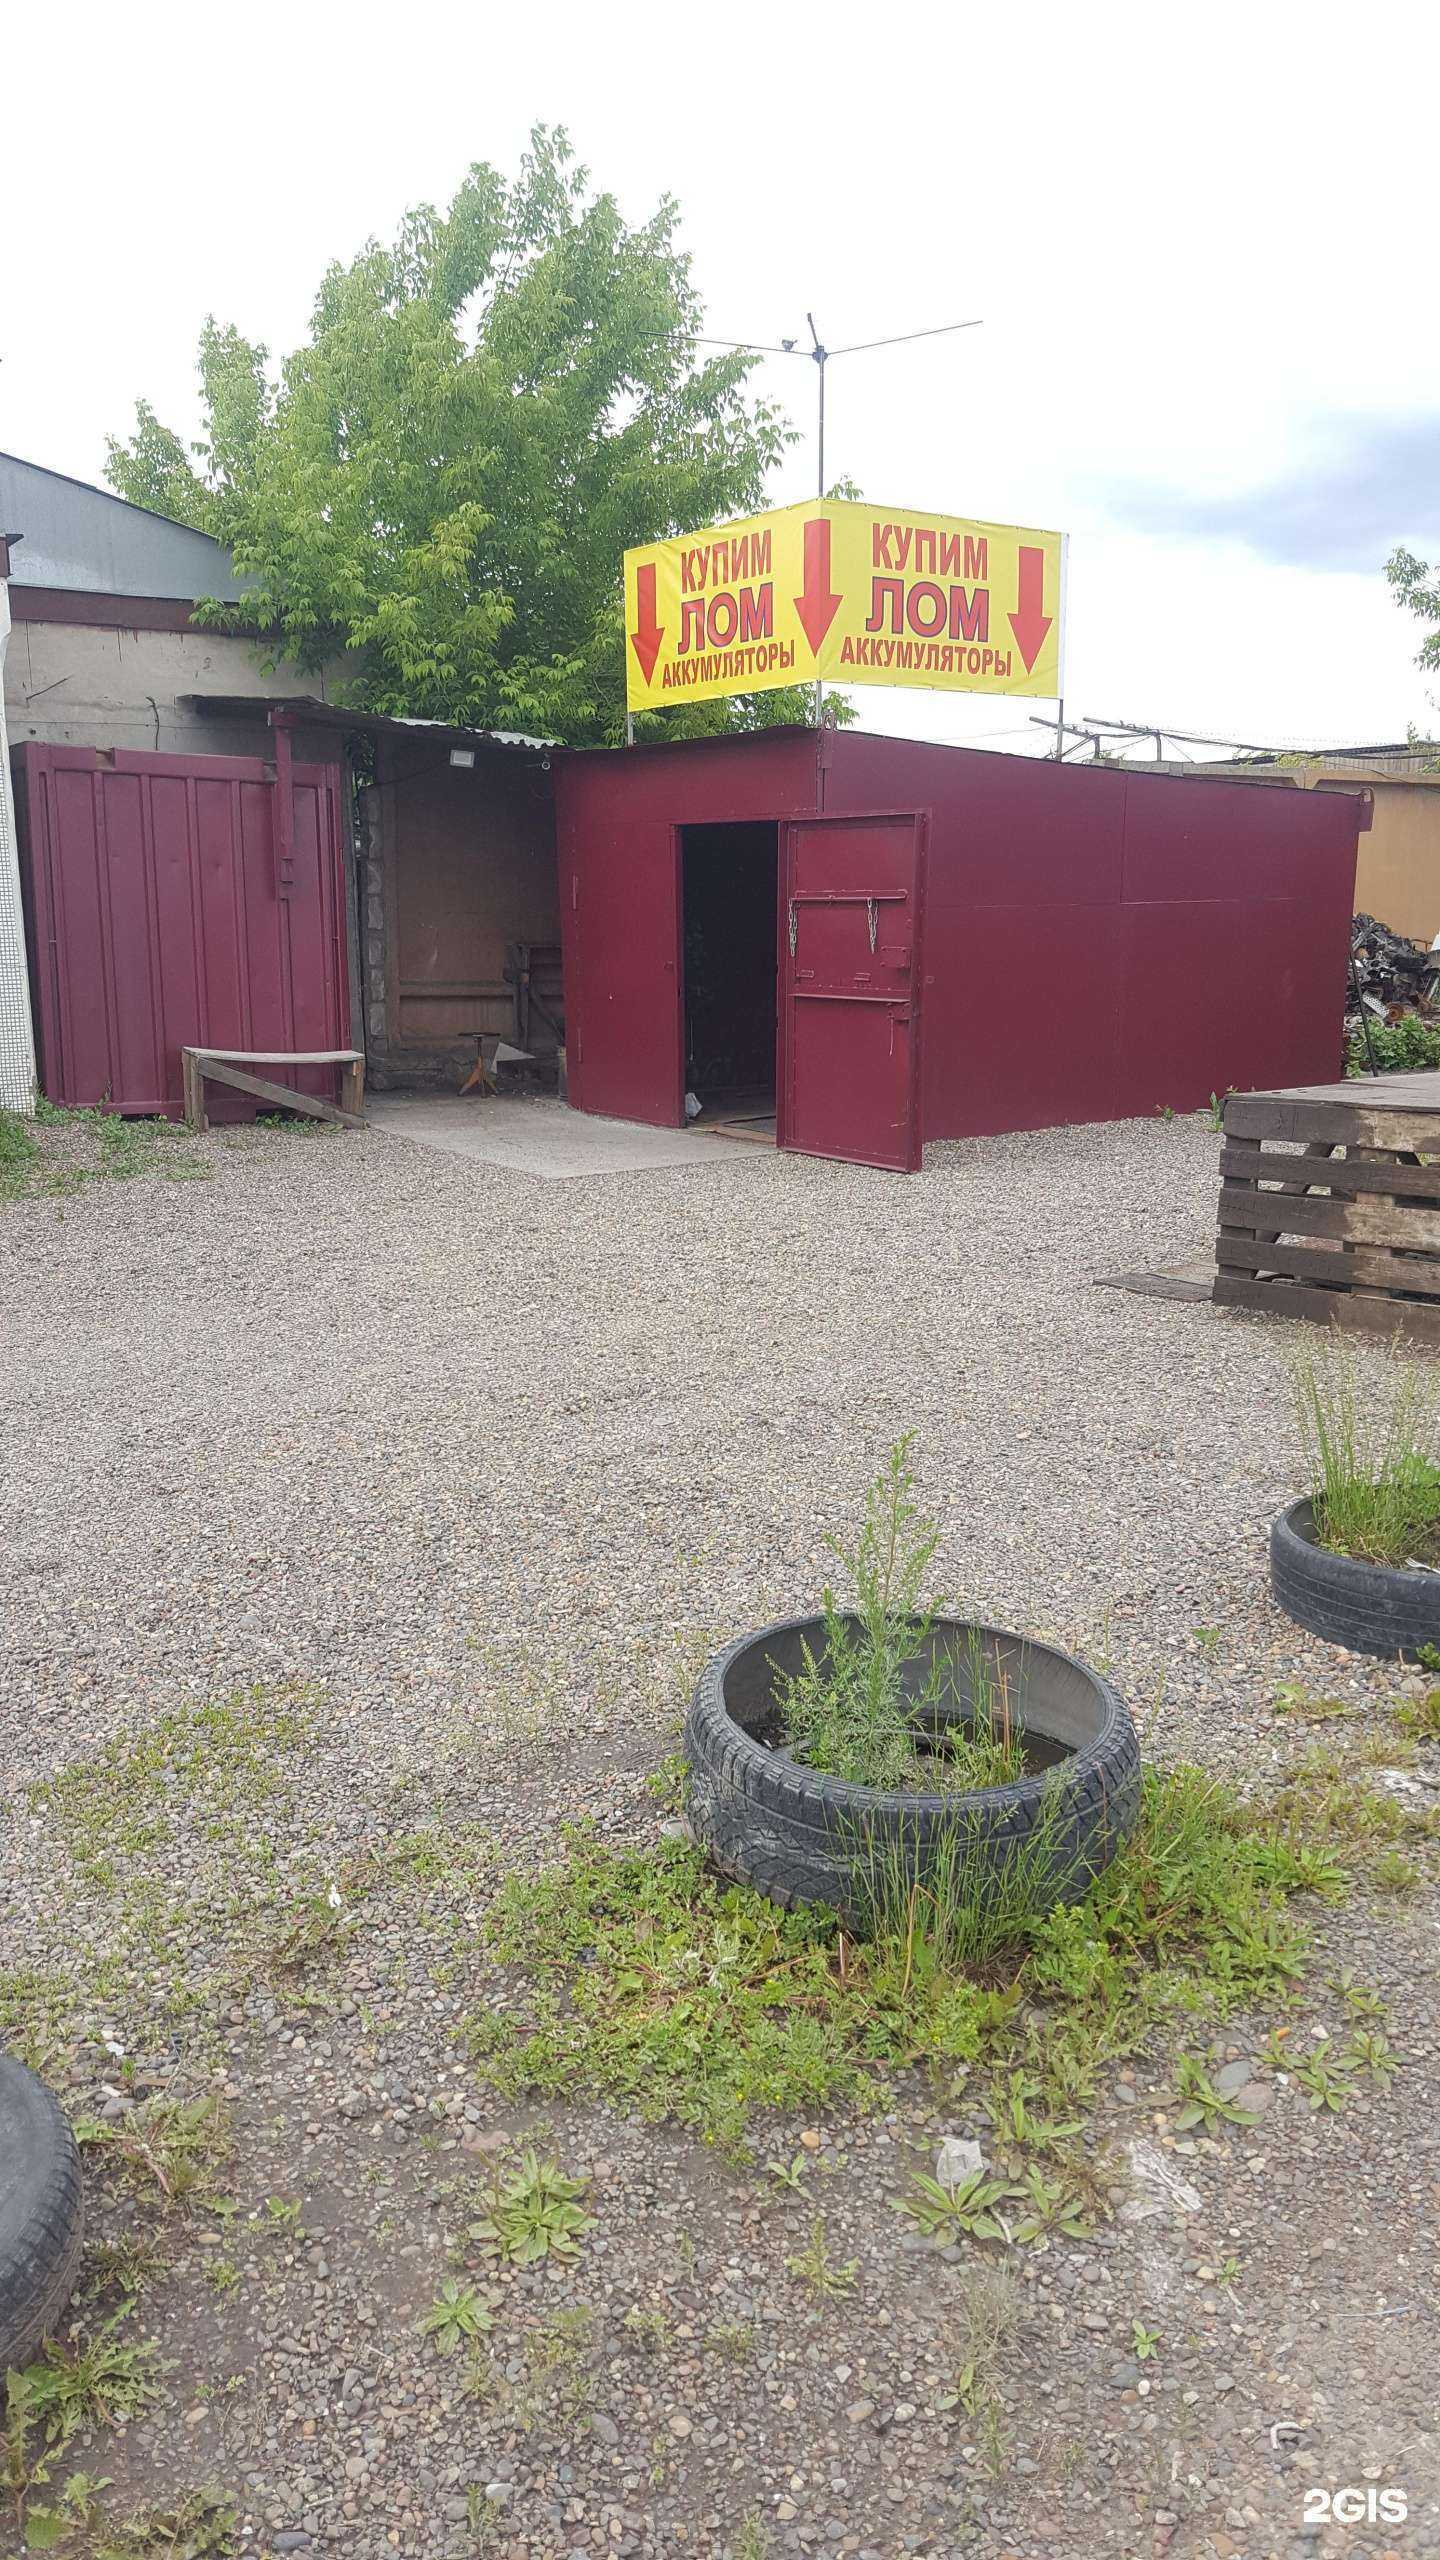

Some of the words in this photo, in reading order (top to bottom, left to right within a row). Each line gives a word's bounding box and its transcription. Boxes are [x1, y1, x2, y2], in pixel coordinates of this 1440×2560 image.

[681, 529, 772, 594] КУПИМ
[872, 522, 988, 581] КУПИМ
[678, 582, 773, 655] ЛОМ
[865, 576, 990, 643] ЛОМ
[662, 639, 795, 688] АККУМУЛЯТОРЫ
[840, 636, 1012, 677] АККУМУЛЯТОРЫ
